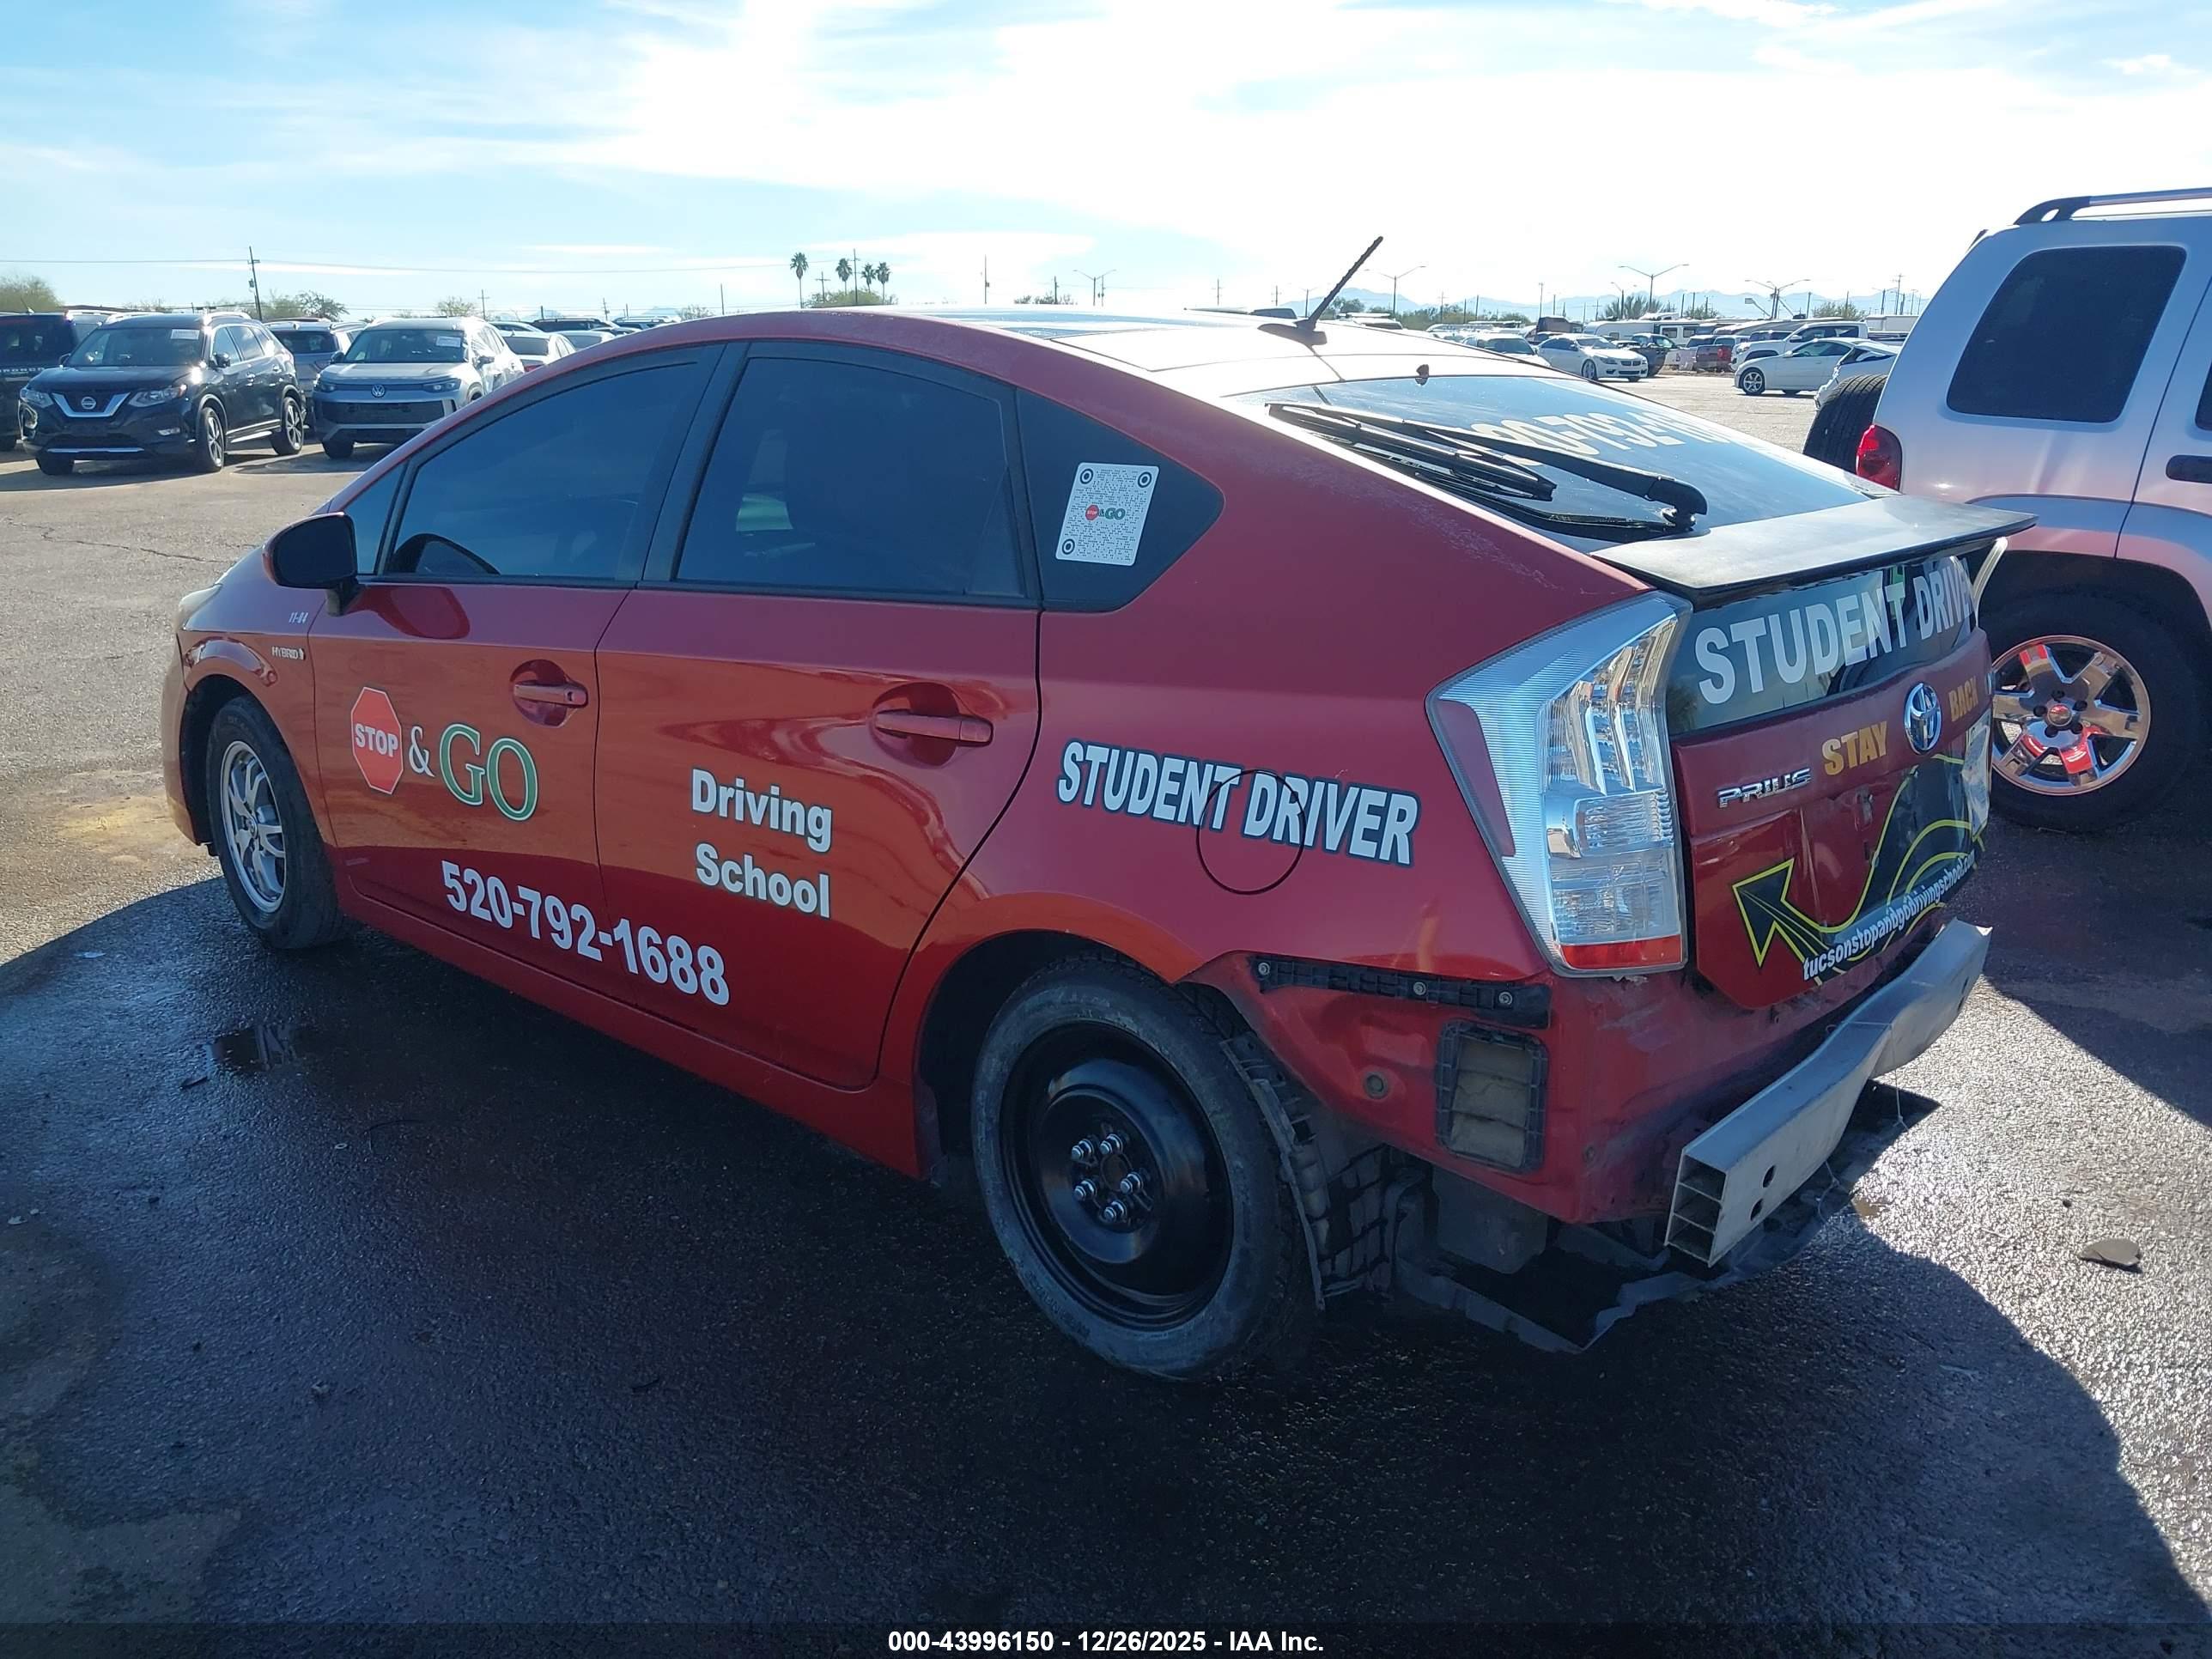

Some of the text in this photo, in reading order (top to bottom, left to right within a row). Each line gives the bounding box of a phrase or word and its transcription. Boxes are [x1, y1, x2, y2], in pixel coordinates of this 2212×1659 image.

[1105, 507, 1126, 520] GO
[271, 646, 299, 659] HYBRID
[1694, 564, 1974, 704] STUDENT DRIVE
[1821, 676, 1978, 775] STAY BACK
[355, 723, 538, 821] STOP & GO
[691, 768, 833, 854] Driving
[1056, 740, 1419, 866] STUDENT DRIVER
[1717, 769, 1811, 808] PRIUS
[696, 842, 831, 920] School
[441, 860, 730, 1006] 520-792-1688
